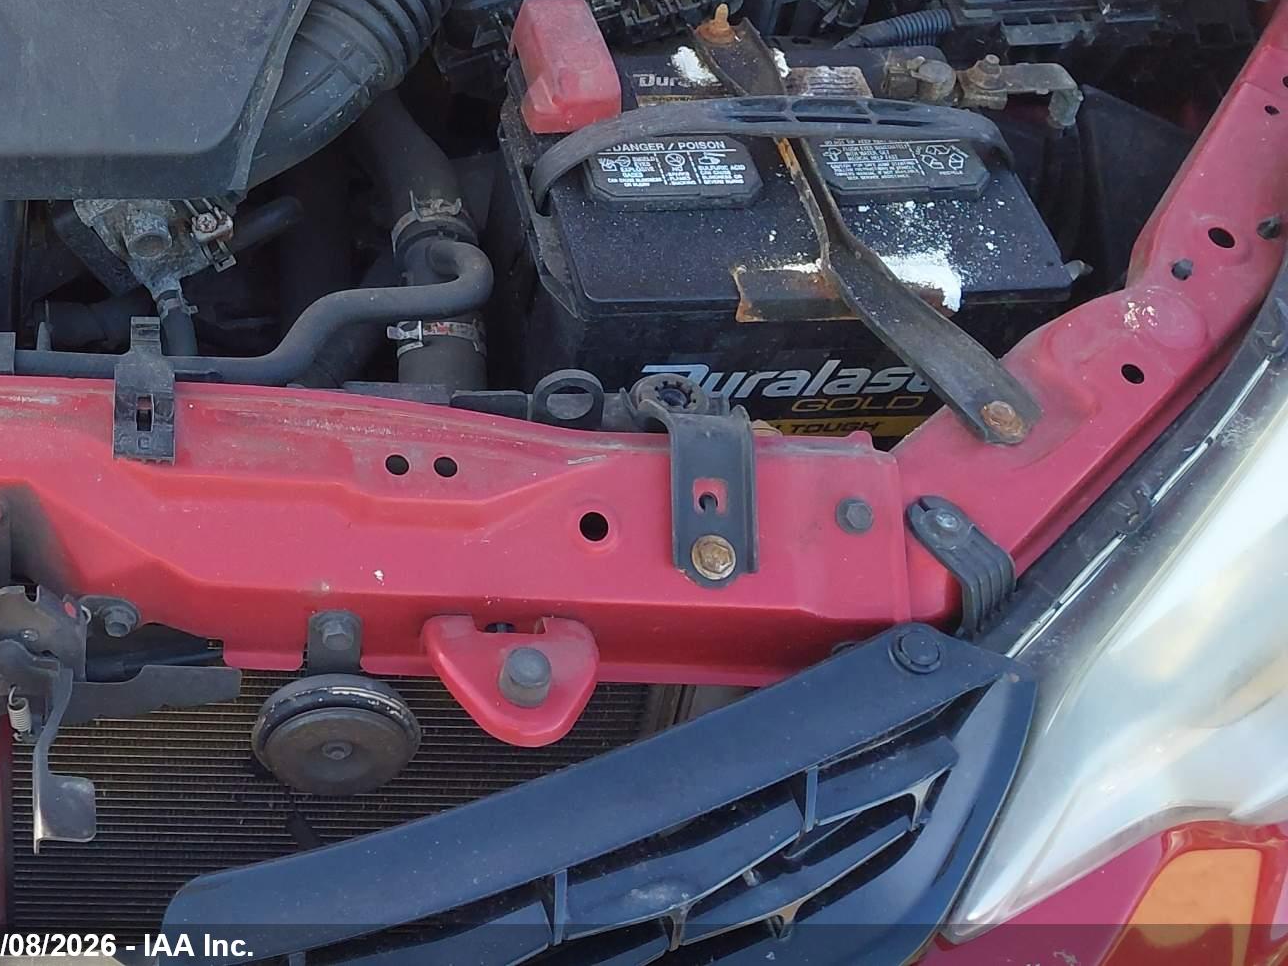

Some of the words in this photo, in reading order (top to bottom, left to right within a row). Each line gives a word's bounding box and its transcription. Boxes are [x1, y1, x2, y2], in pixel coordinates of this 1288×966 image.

[612, 142, 665, 152] DANGER
[678, 141, 726, 150] POISON
[791, 396, 924, 413] GOLD
[791, 421, 883, 435] TOUGH
